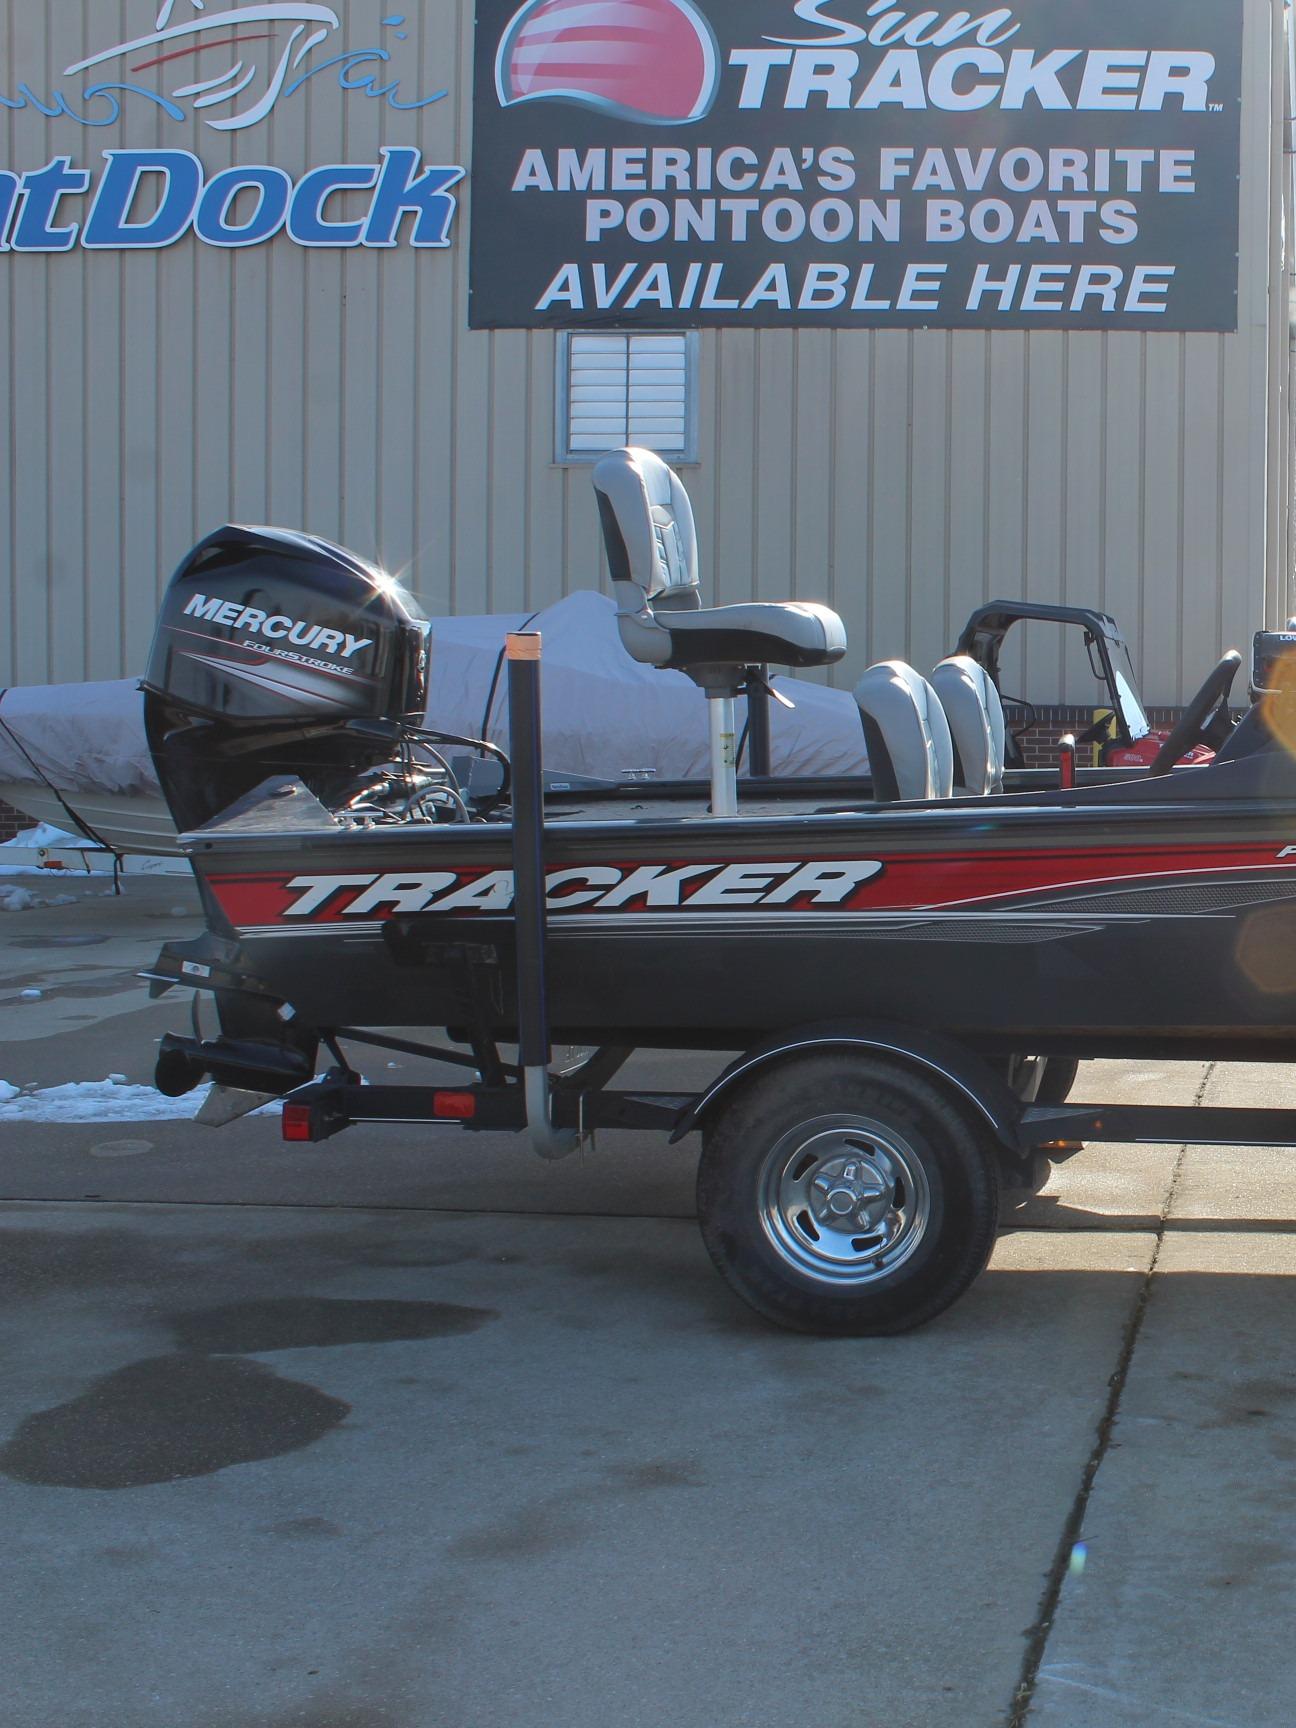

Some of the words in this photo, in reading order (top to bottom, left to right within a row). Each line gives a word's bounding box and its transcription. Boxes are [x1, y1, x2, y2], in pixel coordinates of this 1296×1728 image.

[761, 0, 1021, 47] Sun
[727, 48, 1217, 112] TRACKER
[511, 147, 857, 192] AMERICA'S
[879, 149, 1197, 193] FAVORITE
[585, 199, 900, 243] PONTOON
[925, 199, 1139, 245] BOATS
[534, 263, 948, 311] AVAILABLE
[966, 264, 1177, 313] HERE
[183, 594, 373, 658] MERCURY
[243, 640, 355, 675] FOURSTROKE
